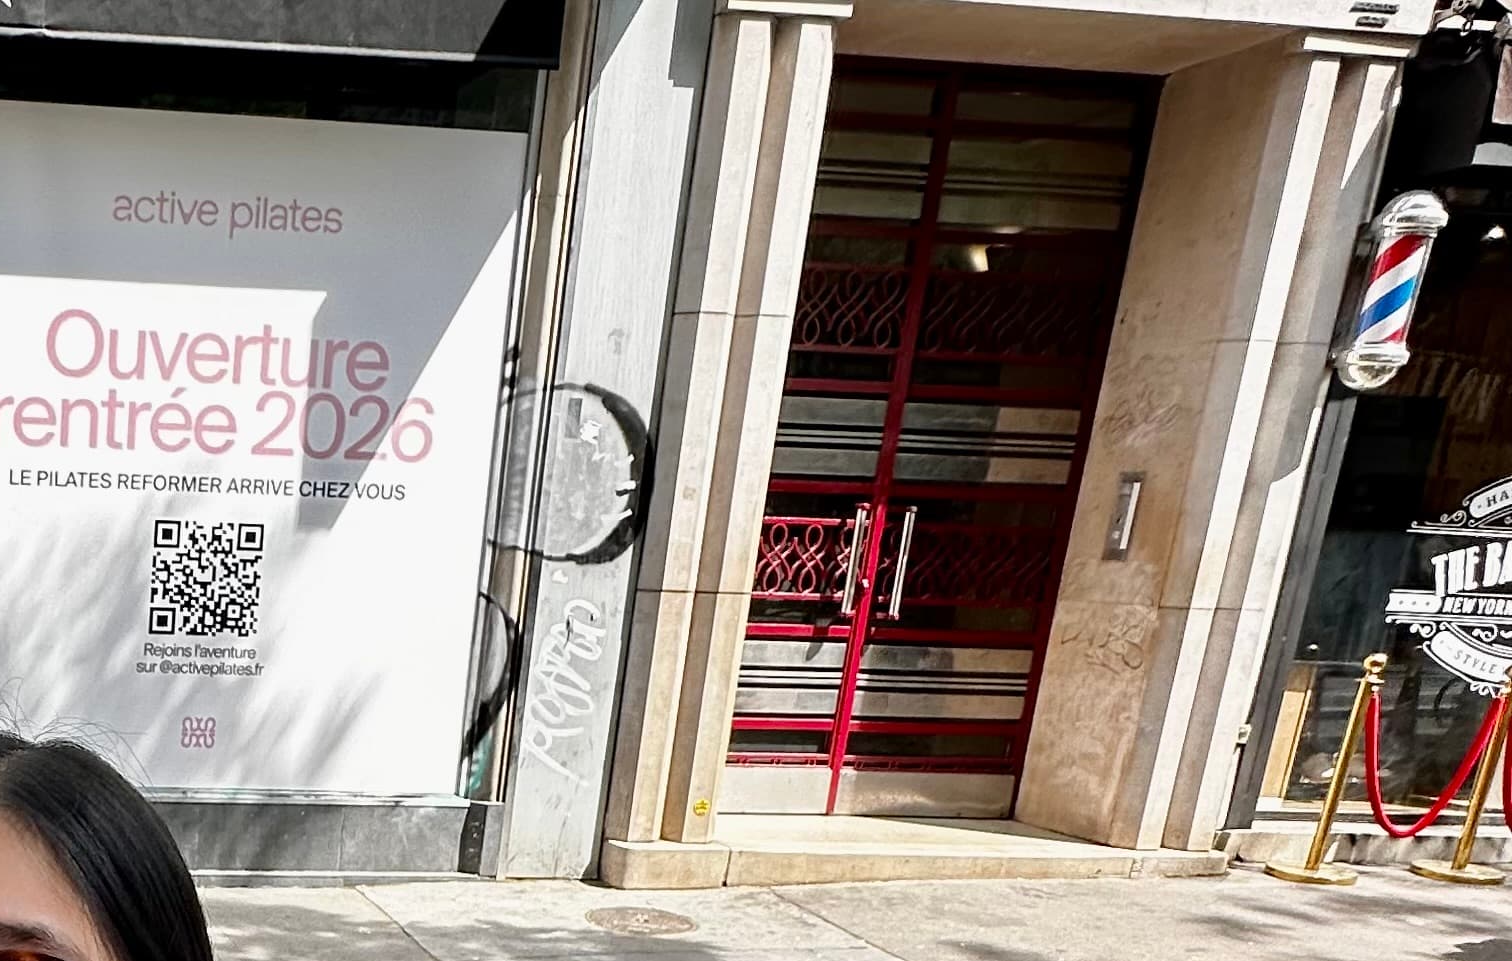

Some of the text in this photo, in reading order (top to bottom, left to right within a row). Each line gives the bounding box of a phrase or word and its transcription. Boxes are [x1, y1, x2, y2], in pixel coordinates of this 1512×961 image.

[112, 191, 344, 240] active pilates
[46, 308, 391, 393] Ouverture
[250, 390, 436, 464] 2026
[8, 468, 407, 501] LE PILATES REFORMER ARRIVE CHEZ VOUS
[1486, 490, 1512, 508] HA
[1431, 540, 1512, 597] THE BA
[1442, 596, 1477, 614] NEW
[143, 642, 257, 660] Rejoins l'aventure
[1454, 650, 1497, 674] STYLE
[135, 660, 265, 677] sur @activepilates.fr
